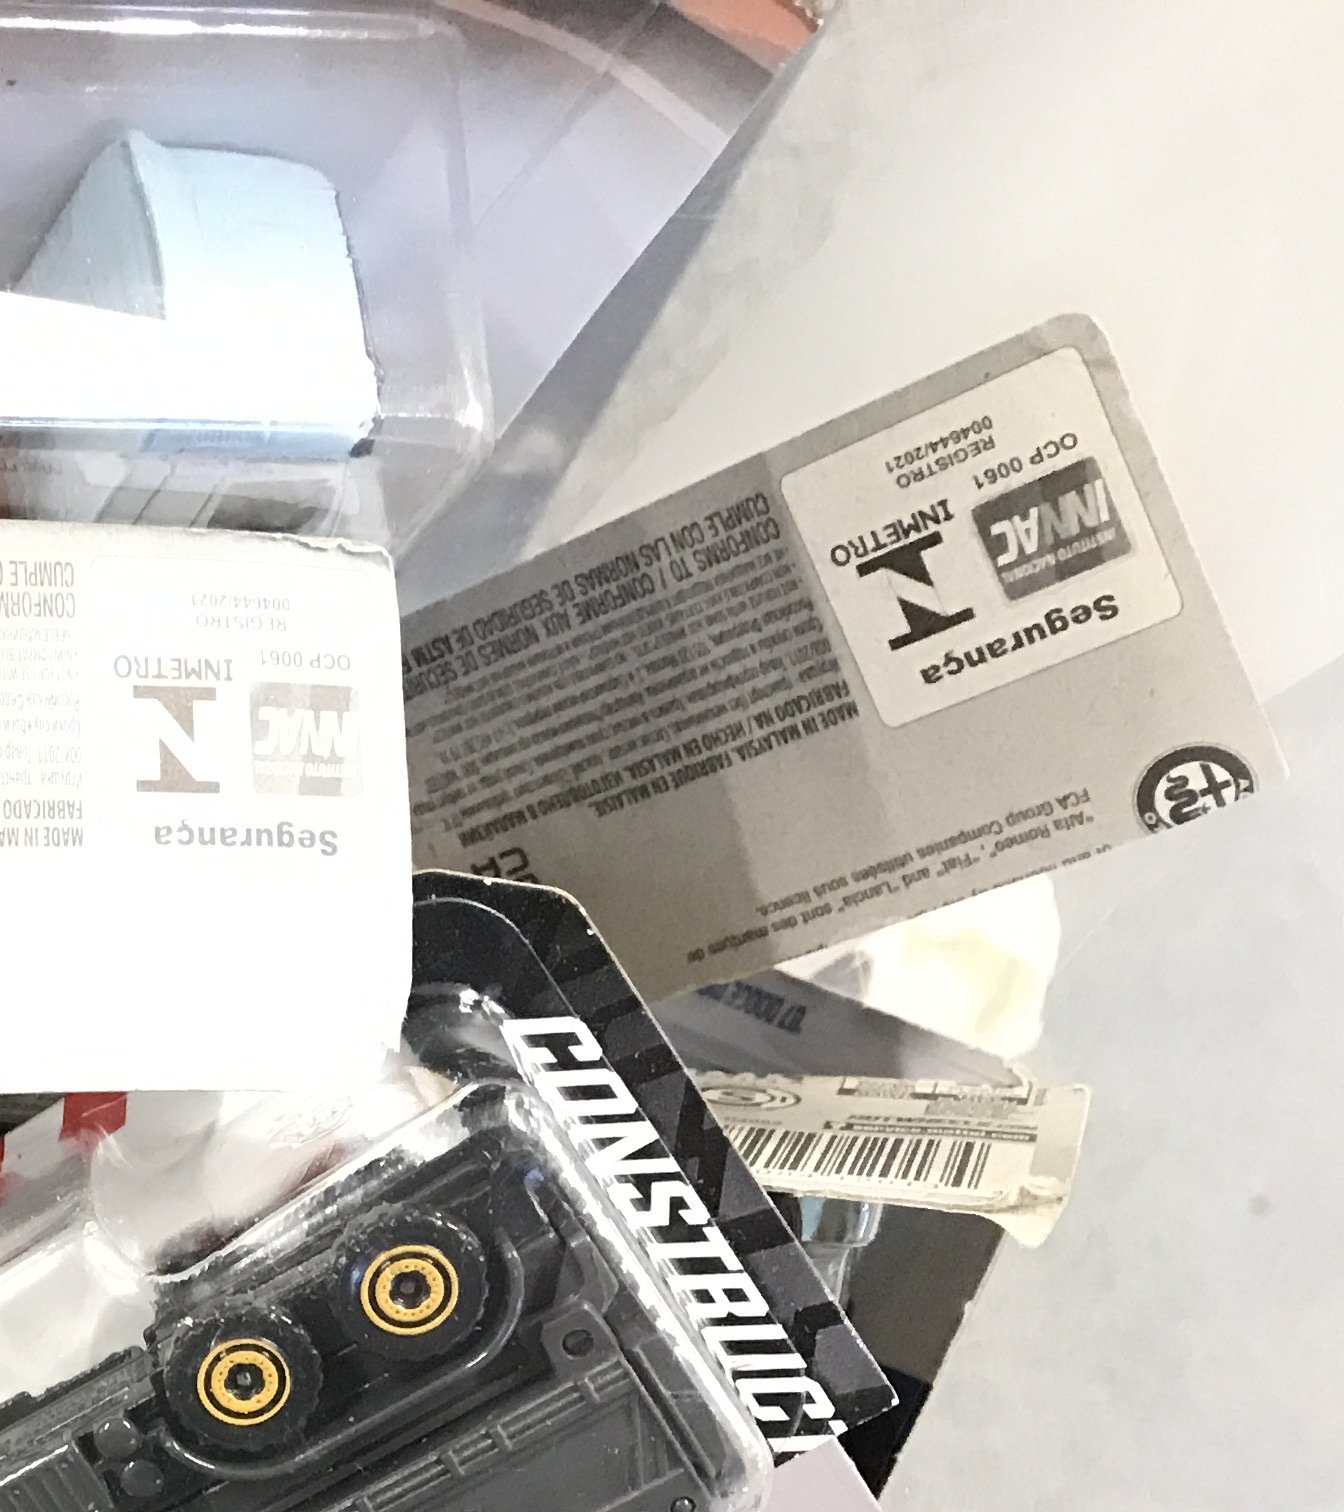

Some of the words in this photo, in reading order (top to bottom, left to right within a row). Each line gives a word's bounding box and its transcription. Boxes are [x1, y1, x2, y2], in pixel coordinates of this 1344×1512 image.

[880, 414, 996, 473] 004644/2021
[1024, 429, 1080, 464] OCP
[890, 434, 998, 489] REGISTRO
[969, 455, 1026, 490] 0061
[700, 492, 770, 539] CUMPLE
[823, 496, 958, 568] INMETRO
[636, 535, 672, 568] LAS
[666, 520, 706, 555] CON
[689, 516, 781, 573] CONFORMS
[8, 559, 74, 585] CUMPLE
[570, 549, 642, 599] NORMAS
[567, 569, 658, 627] CONFORME
[194, 614, 287, 632] REGISTRO
[913, 588, 1123, 688] Segurança
[113, 654, 233, 680] INMETRO
[260, 649, 303, 667] 0061
[309, 652, 350, 668] OCP
[773, 678, 852, 724] FABRICADO
[817, 699, 860, 730] MADE
[1, 797, 82, 820] FABRICADO
[1003, 797, 1054, 830] Group
[1054, 786, 1091, 812] FCA
[44, 827, 83, 848] MADE
[152, 819, 338, 856] Segurança
[914, 816, 1003, 862] Companies
